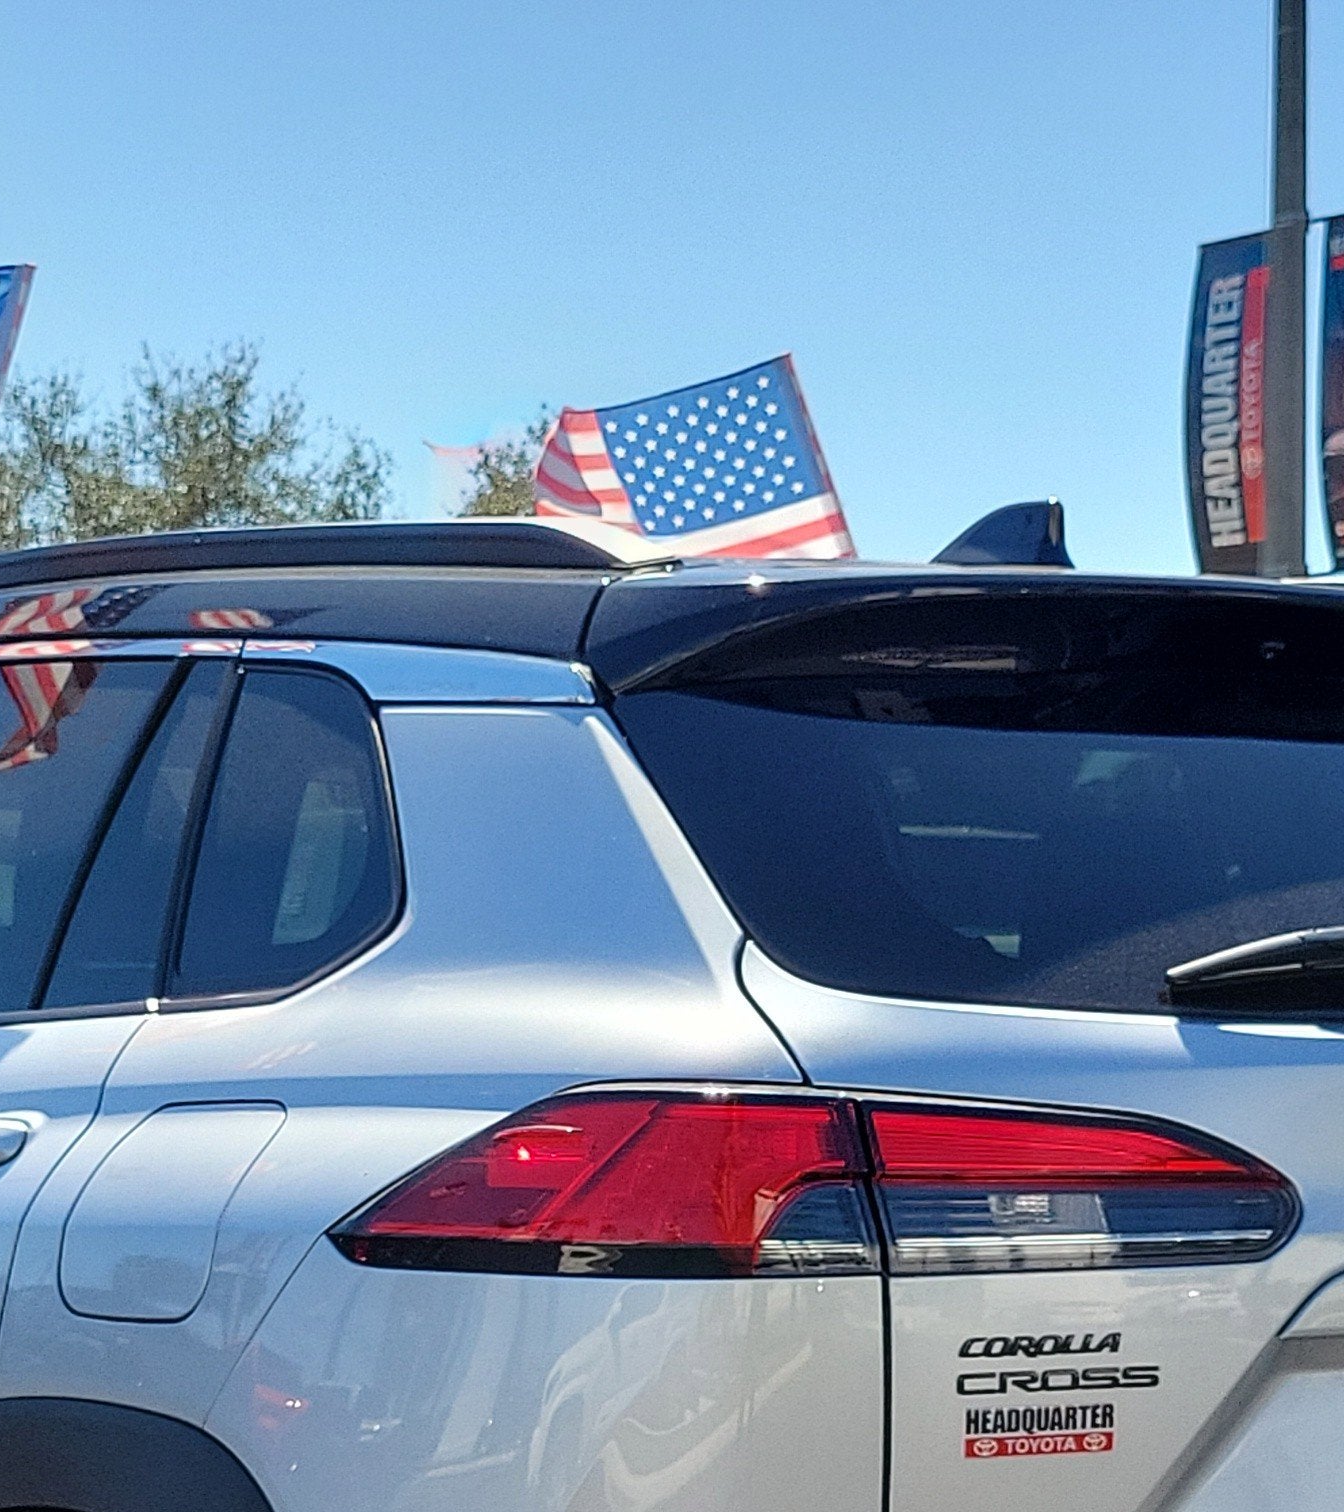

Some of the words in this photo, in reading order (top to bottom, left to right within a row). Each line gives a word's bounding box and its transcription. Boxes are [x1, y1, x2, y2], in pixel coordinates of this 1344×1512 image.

[1200, 273, 1247, 549] HEADQUARTER
[958, 1332, 1122, 1358] COROLLA
[956, 1365, 1160, 1395] CROSS
[965, 1403, 1115, 1435] HEADQUARTER
[1004, 1437, 1077, 1455] TOYOTA
